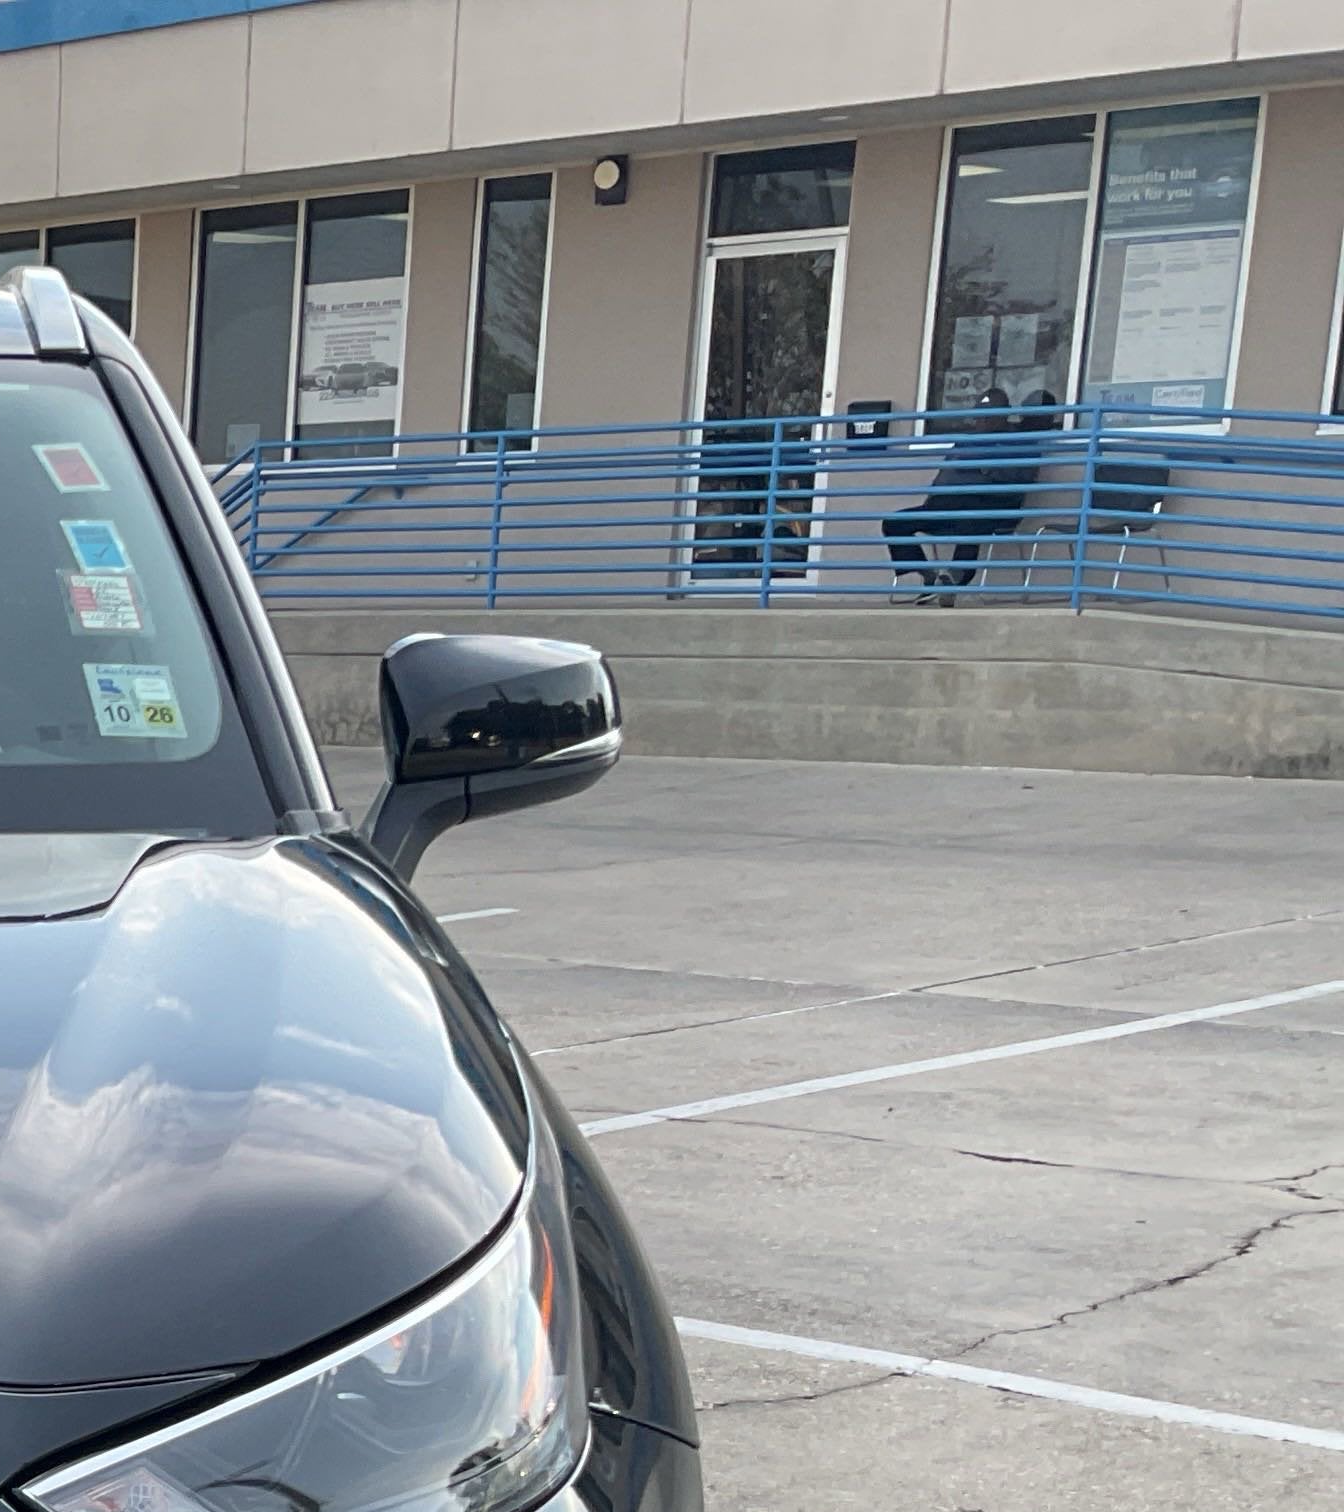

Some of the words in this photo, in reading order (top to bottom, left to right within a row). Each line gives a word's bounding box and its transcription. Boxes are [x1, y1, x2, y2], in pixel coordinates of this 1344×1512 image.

[1109, 171, 1165, 186] Benefits
[1170, 168, 1196, 179] that
[1106, 190, 1140, 203] work
[1145, 187, 1162, 200] for
[1167, 187, 1193, 202] you
[103, 704, 131, 723] 10
[145, 705, 174, 724] 26
